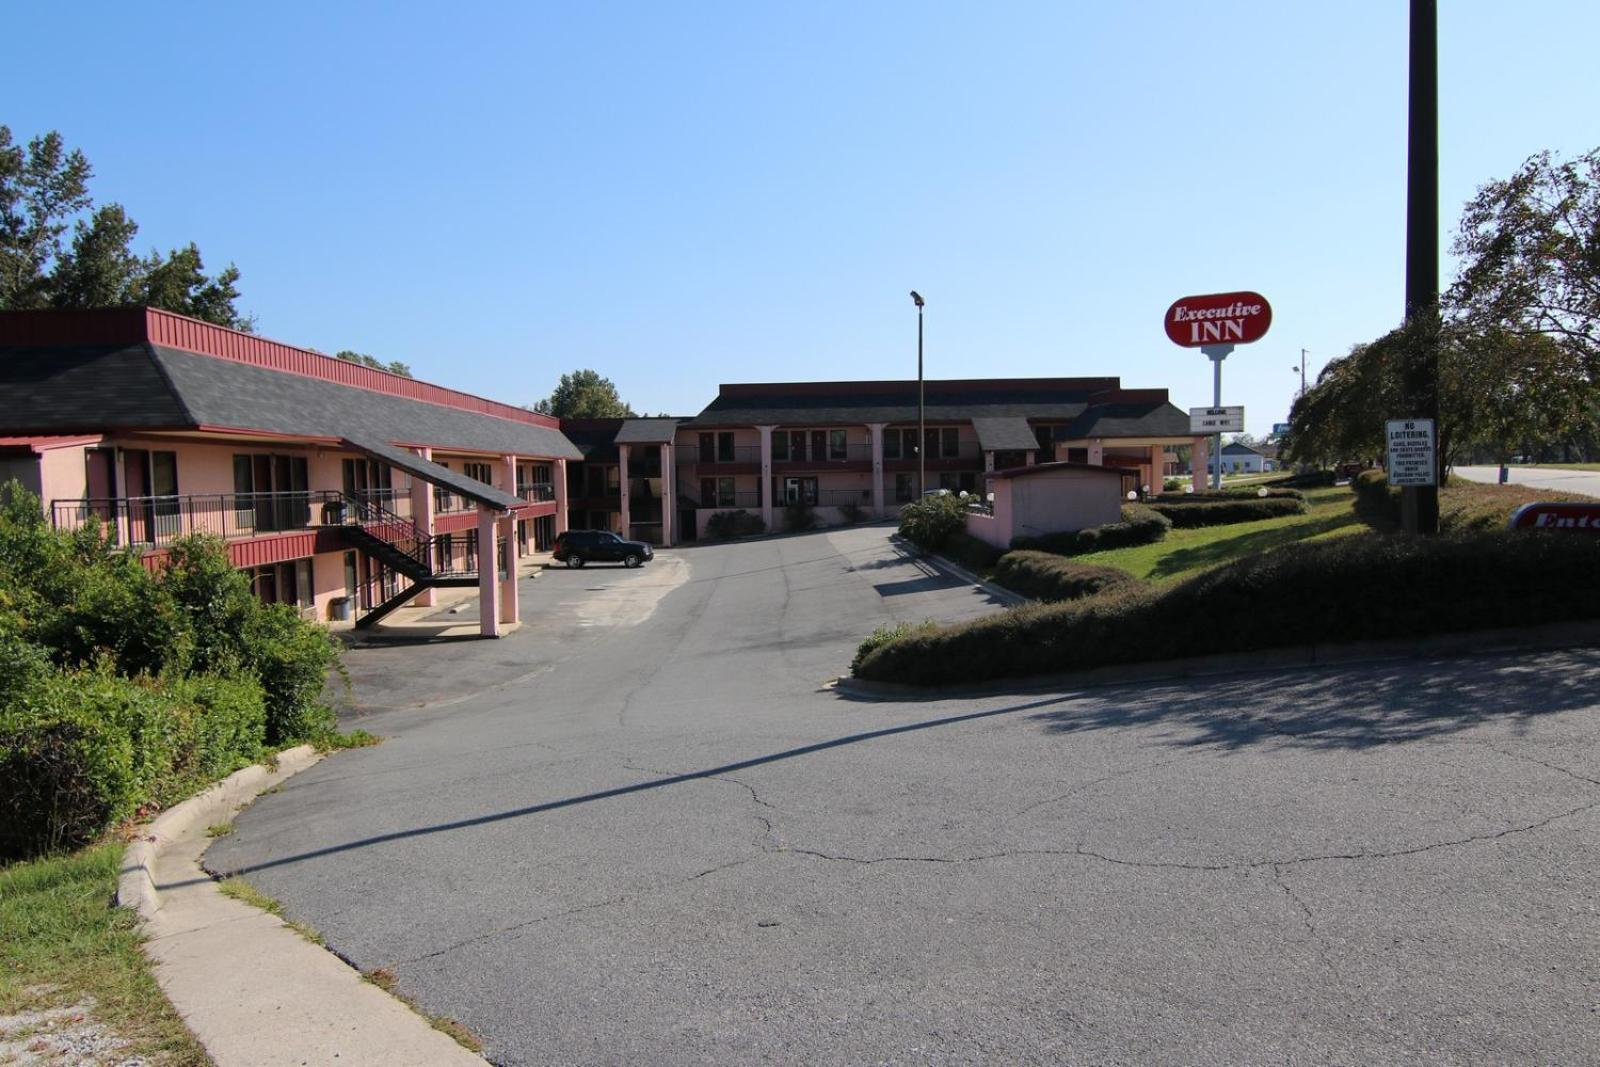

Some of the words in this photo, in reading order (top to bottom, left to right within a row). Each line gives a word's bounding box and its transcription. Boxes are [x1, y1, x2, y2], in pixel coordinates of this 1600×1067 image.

[1173, 302, 1261, 322] Executive
[1191, 318, 1245, 343] INN
[1405, 422, 1415, 430] NO
